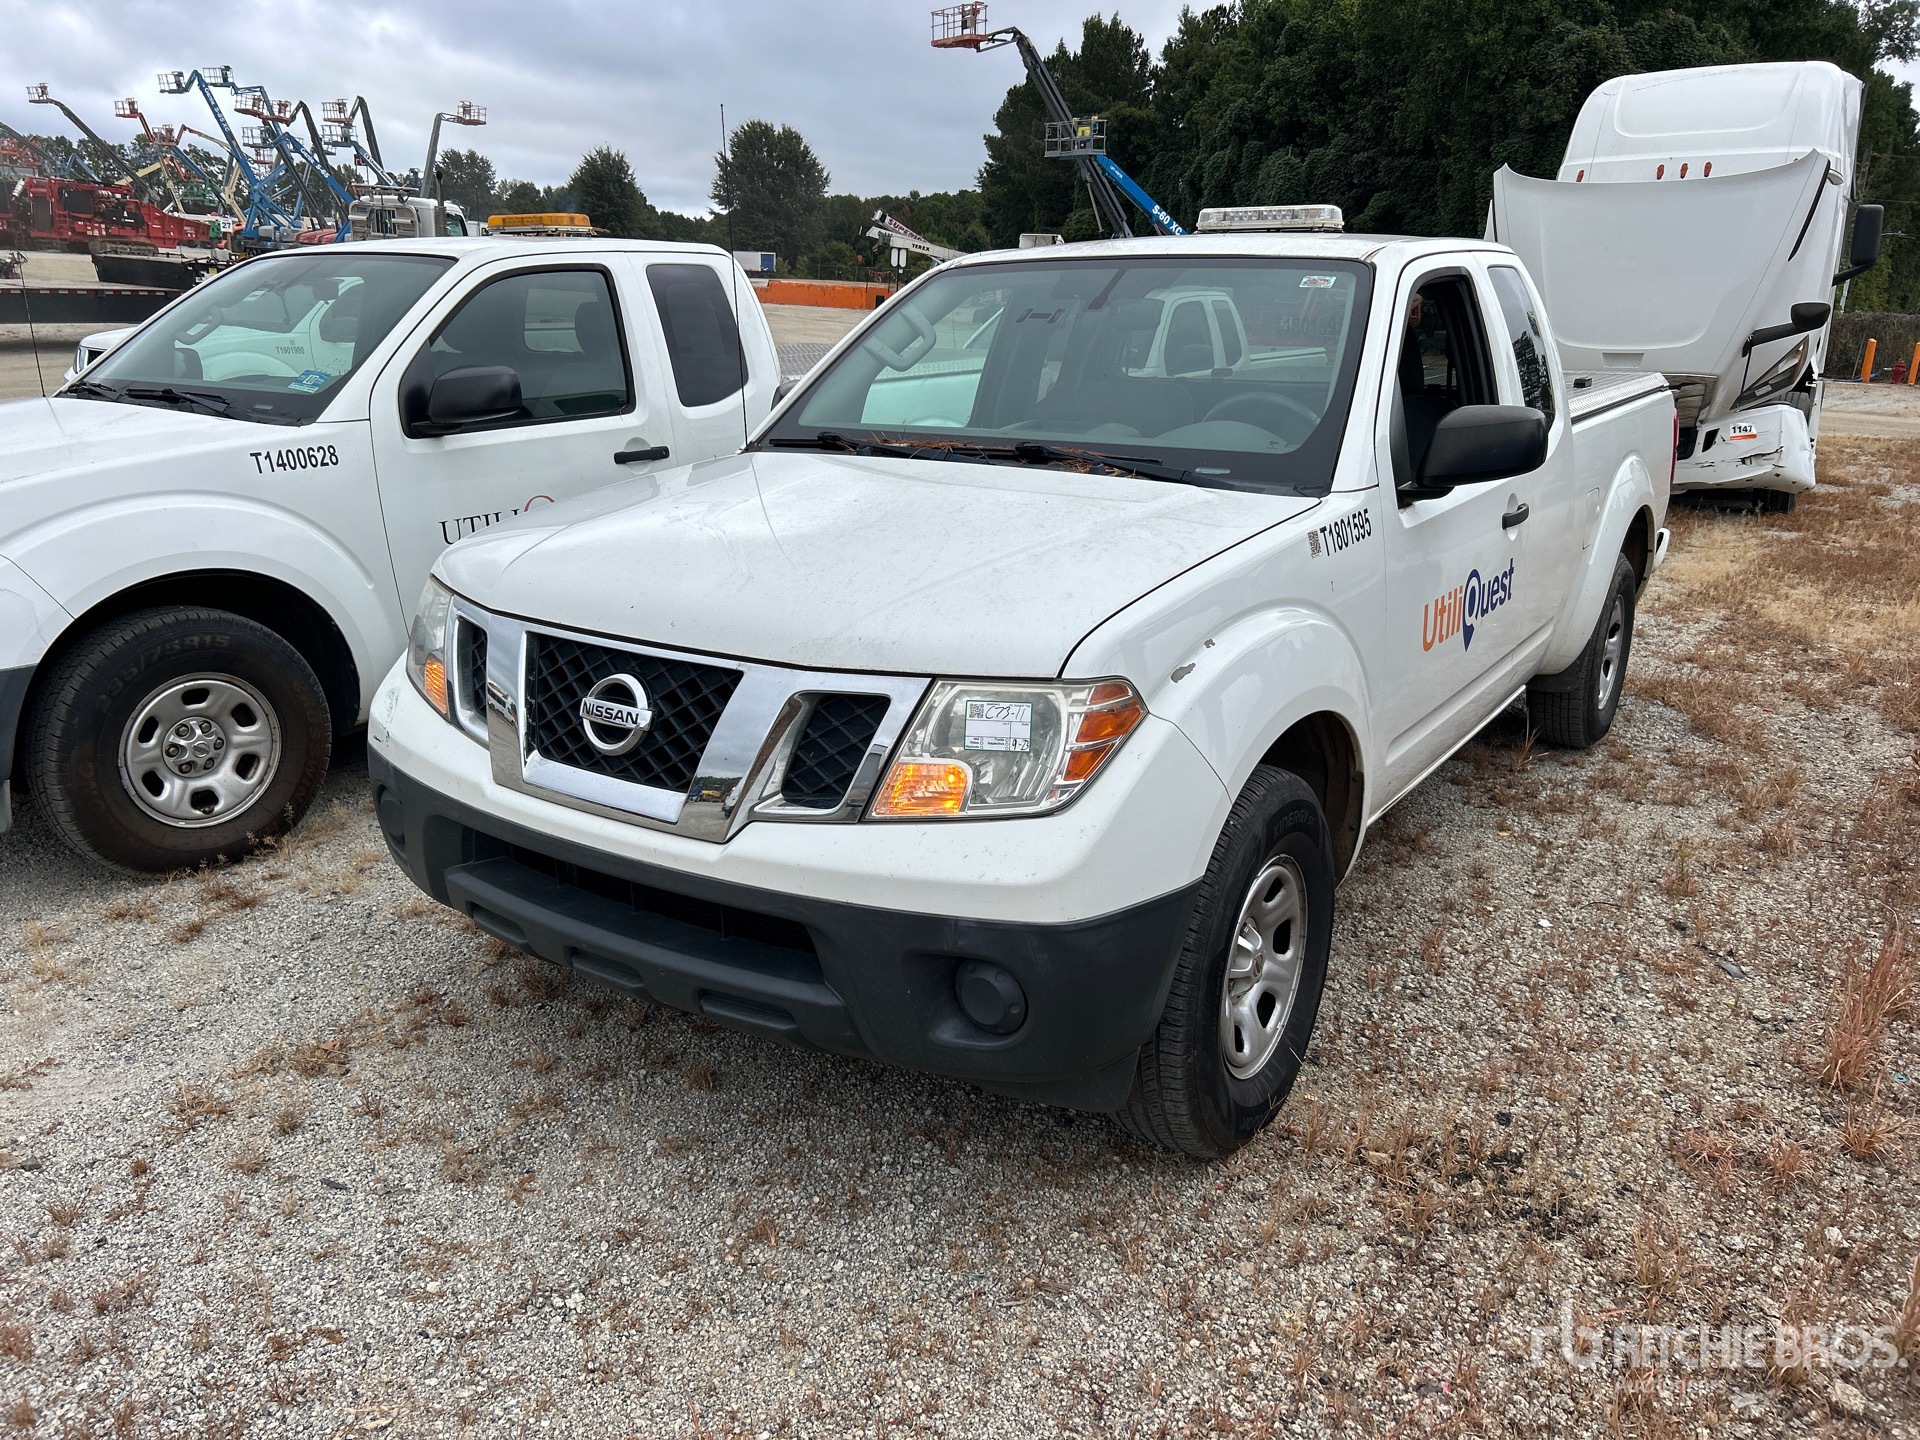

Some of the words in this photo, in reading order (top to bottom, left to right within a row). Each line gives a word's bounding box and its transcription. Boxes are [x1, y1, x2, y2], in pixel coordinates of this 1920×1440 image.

[221, 221, 231, 229] 27
[1152, 204, 1171, 225] S-60
[1169, 221, 1183, 236] XC
[911, 243, 931, 252] TEREX
[1731, 425, 1753, 434] 1147
[249, 444, 339, 474] T1400628
[1319, 508, 1372, 557] T1801595
[1422, 557, 1515, 653] UtiliQuest
[582, 701, 640, 725] NISSAN
